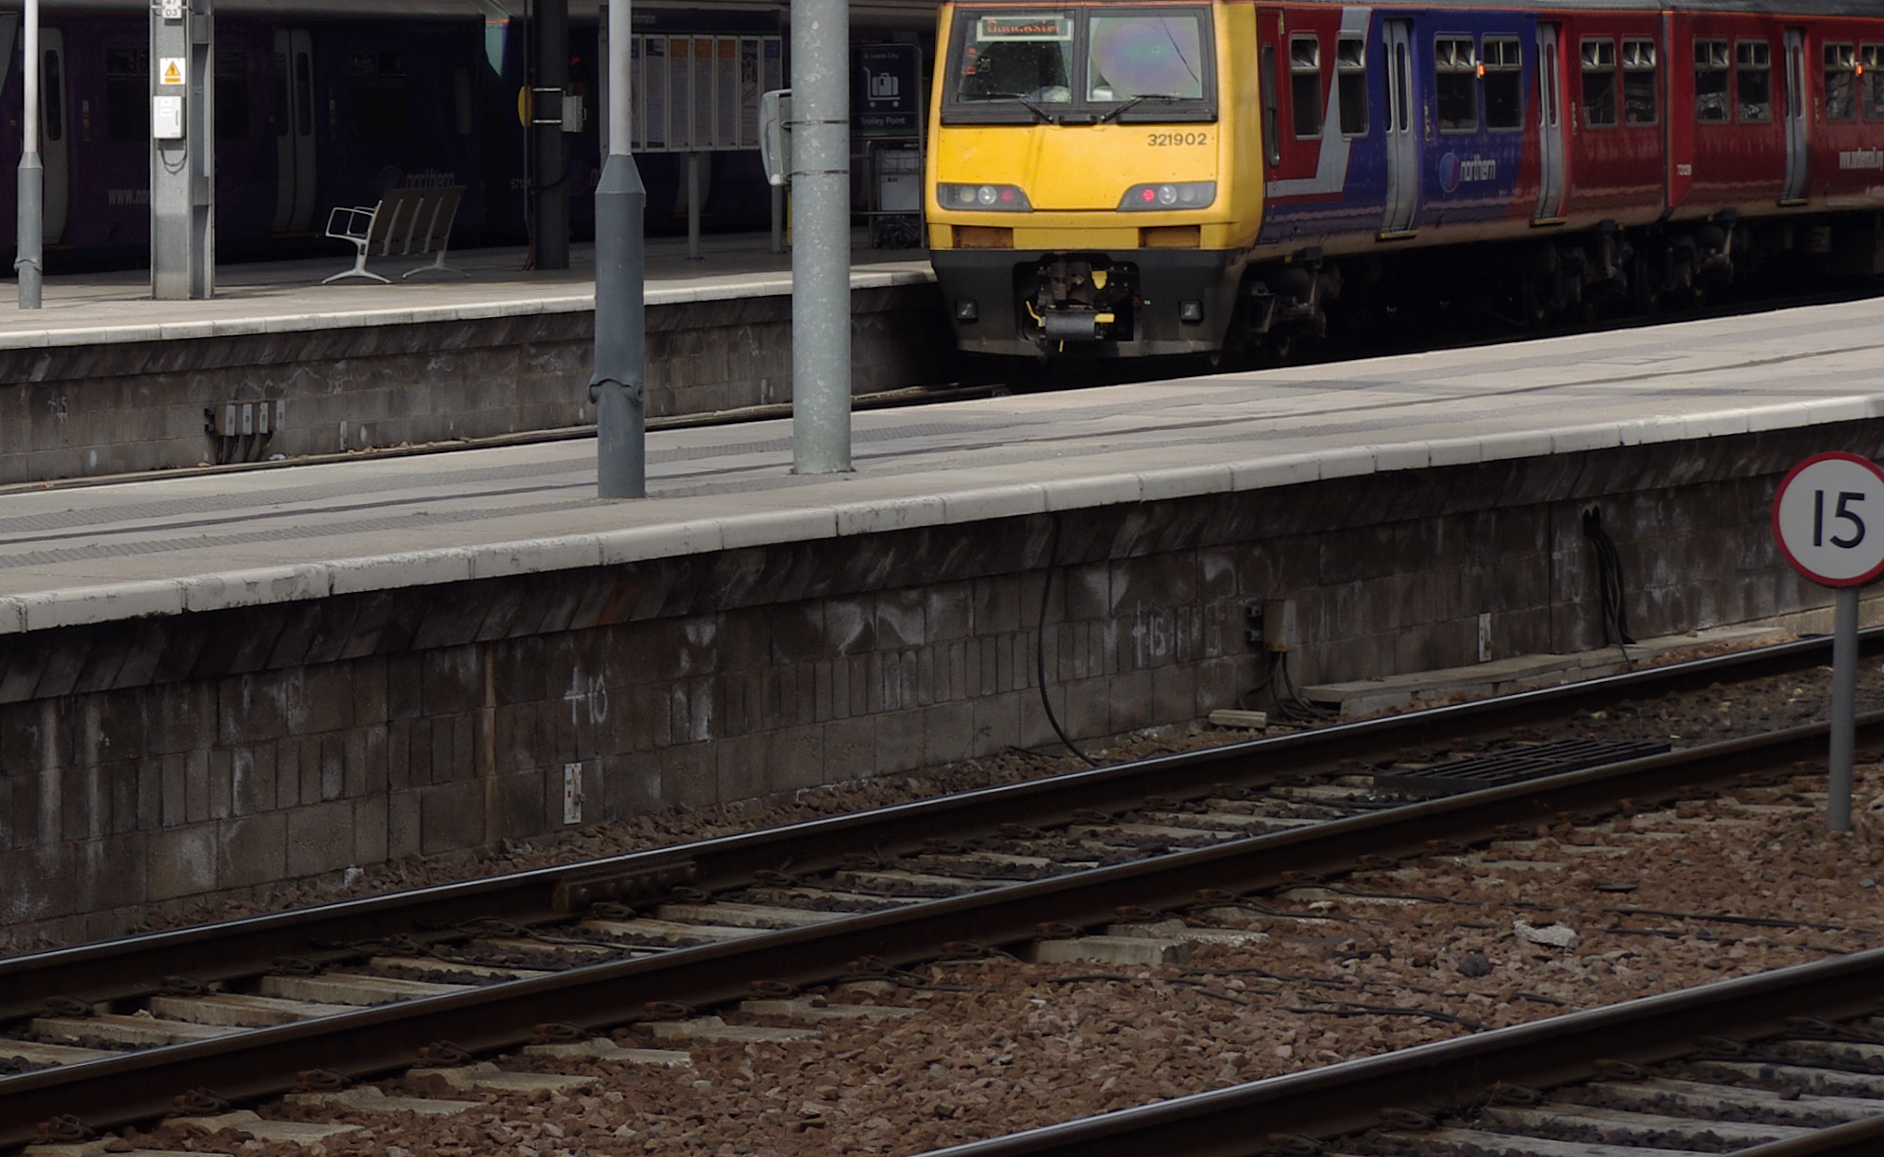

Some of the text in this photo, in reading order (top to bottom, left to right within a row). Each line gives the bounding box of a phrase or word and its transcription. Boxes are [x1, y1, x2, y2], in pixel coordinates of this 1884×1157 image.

[860, 115, 906, 127] Trolley Point
[1147, 132, 1208, 147] 321902
[406, 167, 455, 188] northern
[1459, 153, 1497, 183] northern
[1812, 489, 1866, 549] 15
